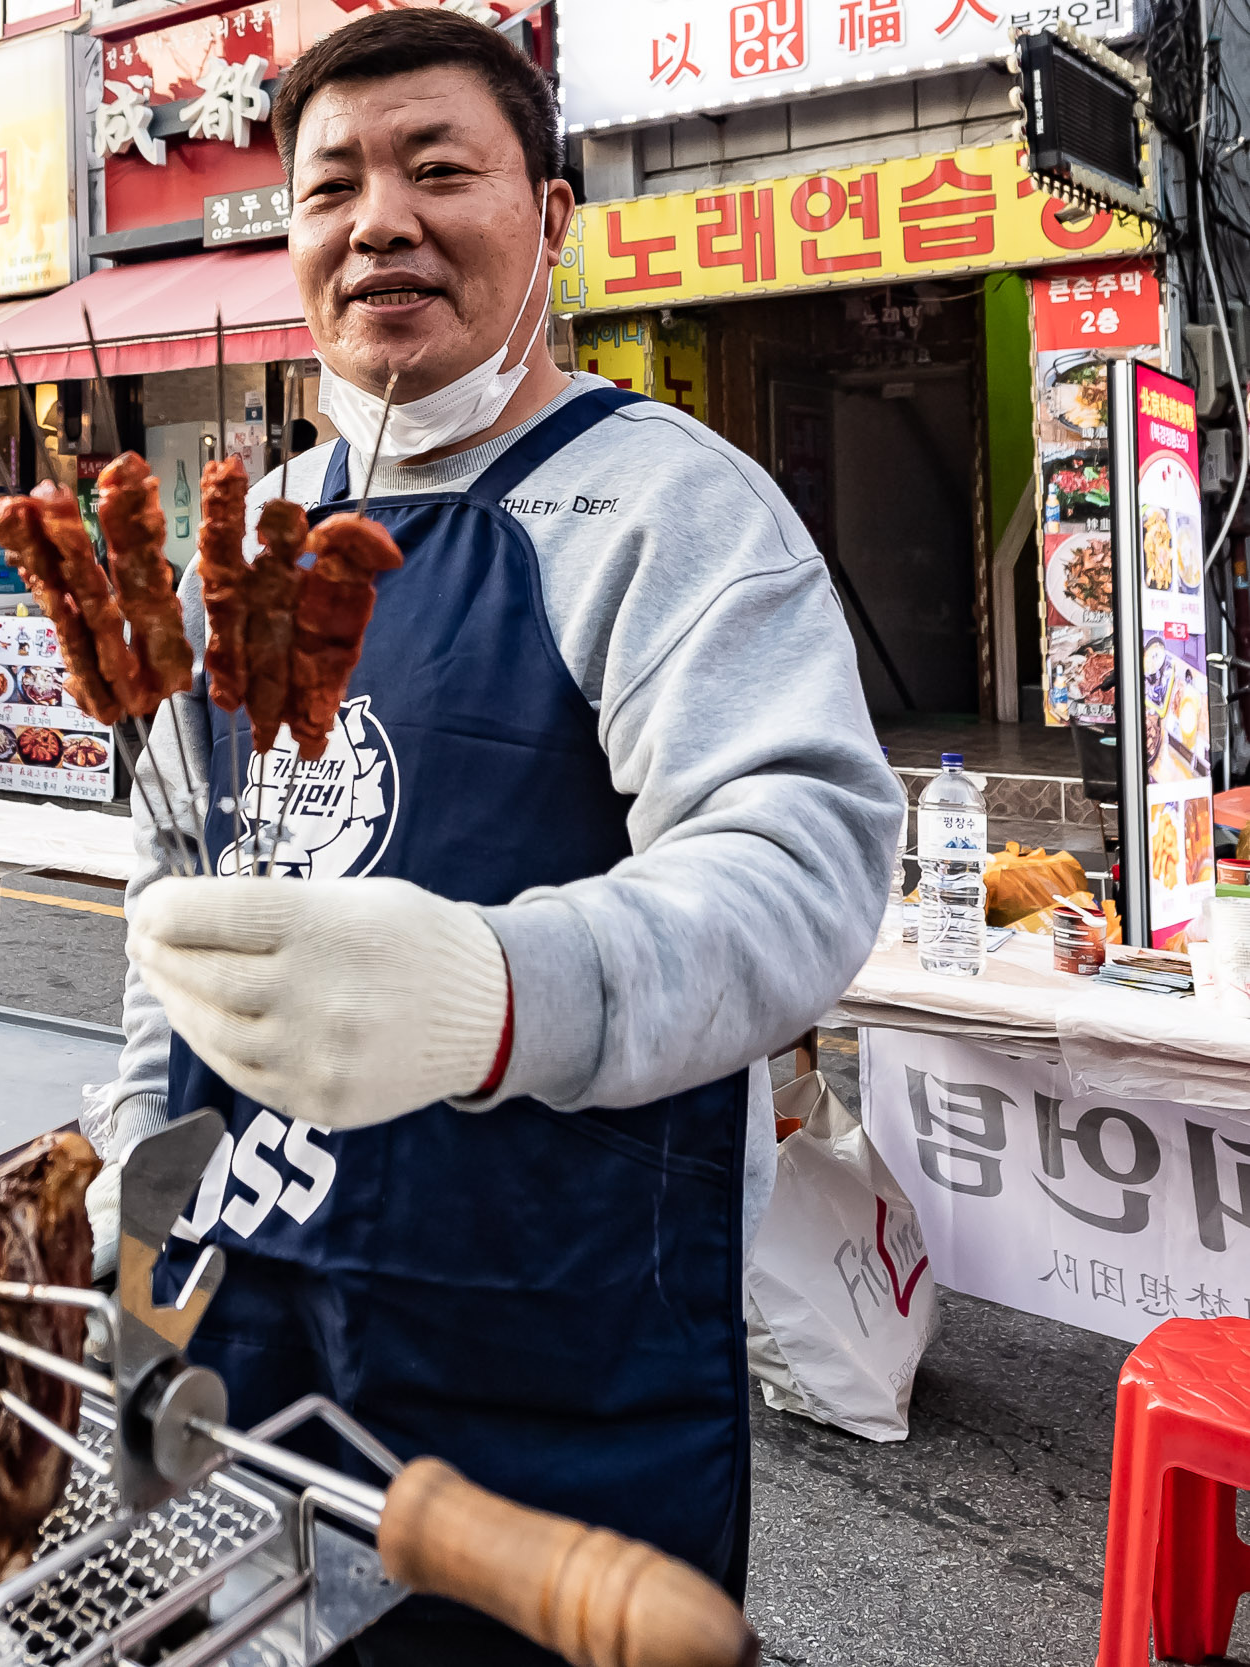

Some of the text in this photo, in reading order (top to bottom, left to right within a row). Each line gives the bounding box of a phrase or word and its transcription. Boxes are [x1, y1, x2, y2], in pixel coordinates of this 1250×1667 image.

[650, 23, 701, 86] 以
[734, 0, 796, 42] DU
[734, 31, 800, 76] CK
[94, 53, 271, 165] 成都
[1049, 270, 1143, 303] 큰손주막
[1080, 307, 1120, 334] 2층
[943, 816, 975, 830] 평창수
